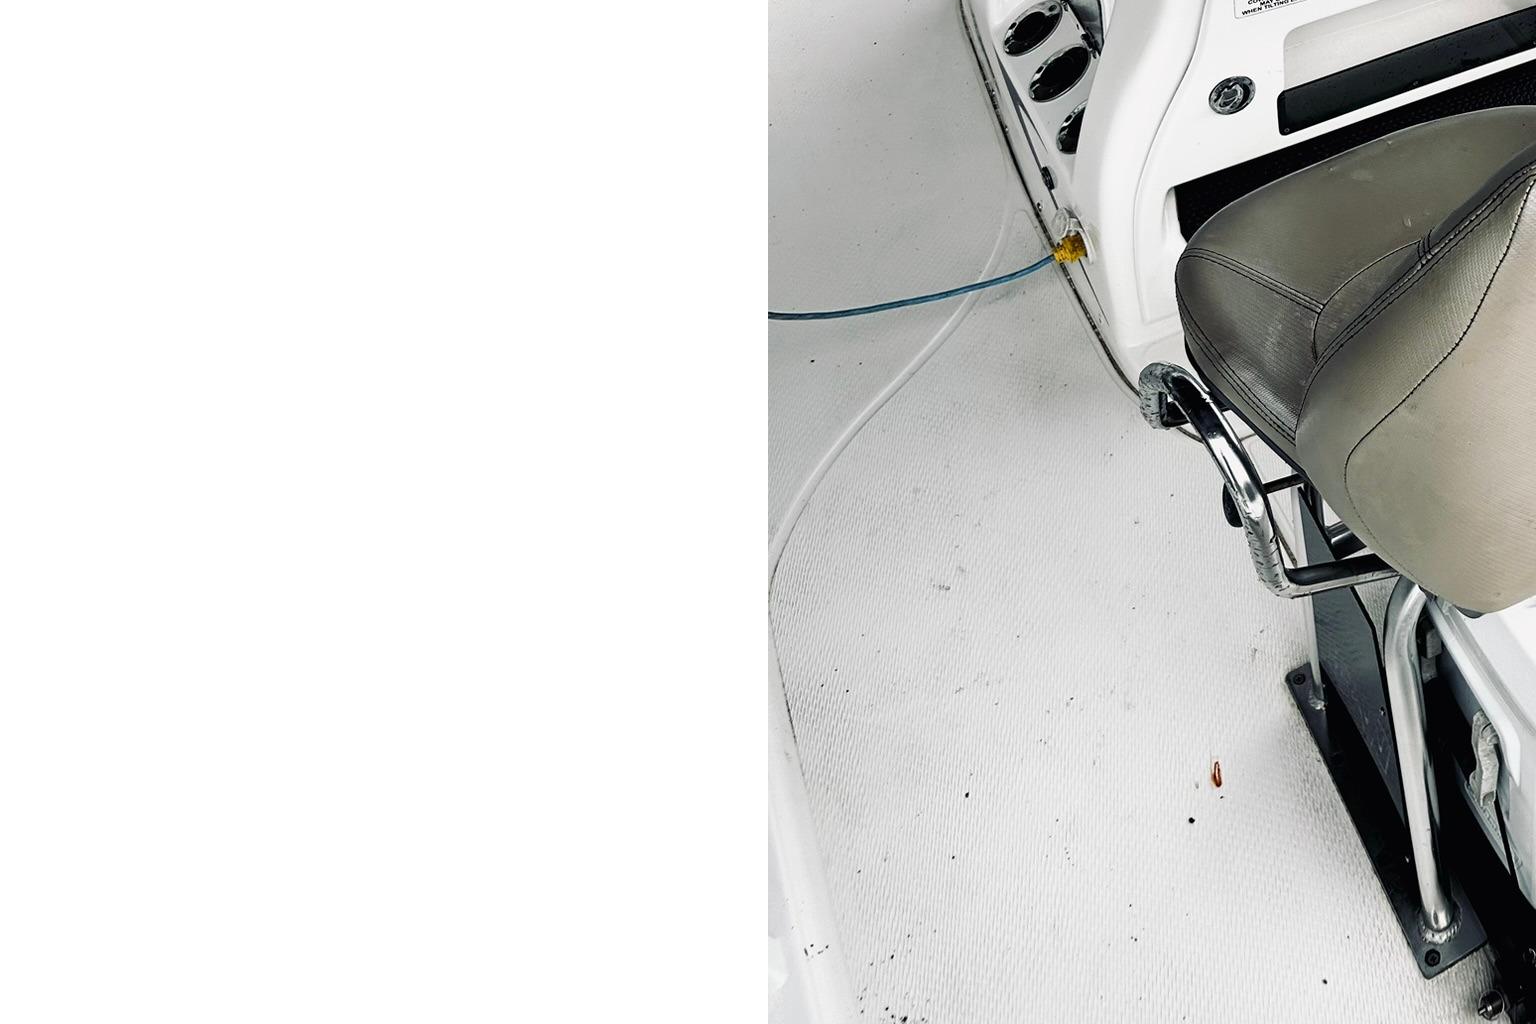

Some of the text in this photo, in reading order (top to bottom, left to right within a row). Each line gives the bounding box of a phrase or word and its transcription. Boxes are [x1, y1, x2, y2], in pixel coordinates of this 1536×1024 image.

[1241, 6, 1263, 16] WHEN
[1264, 0, 1289, 10] TILTING
[1260, 0, 1274, 7] MAY
